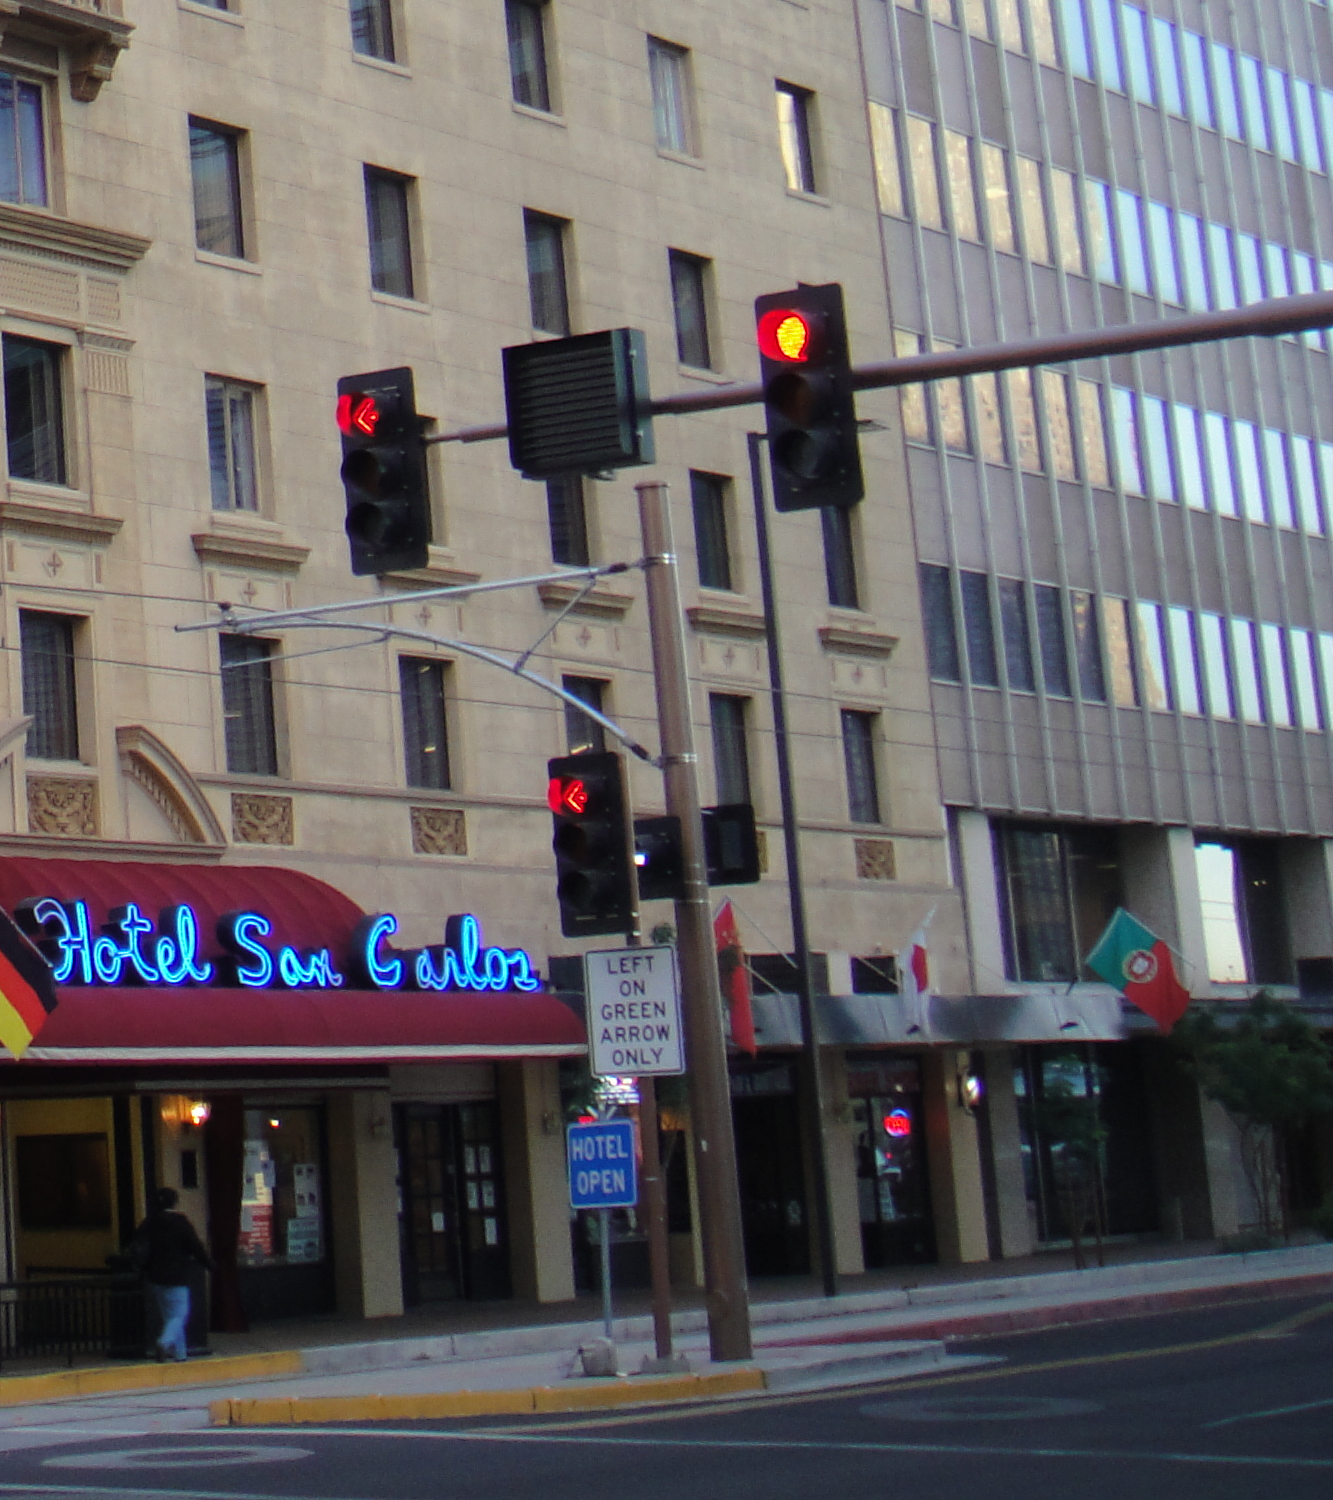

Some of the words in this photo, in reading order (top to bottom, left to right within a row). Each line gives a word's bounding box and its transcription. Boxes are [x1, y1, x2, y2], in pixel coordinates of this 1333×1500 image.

[33, 899, 212, 983] Hotel
[234, 910, 343, 986] San
[365, 912, 539, 992] Carlos
[607, 956, 655, 974] LEFT
[619, 979, 646, 997] ON
[601, 1002, 667, 1021] GREEN
[600, 1024, 670, 1044] ARROW
[612, 1047, 664, 1067] ONLY
[572, 1135, 629, 1161] HOTEL
[577, 1169, 626, 1195] OPEN
